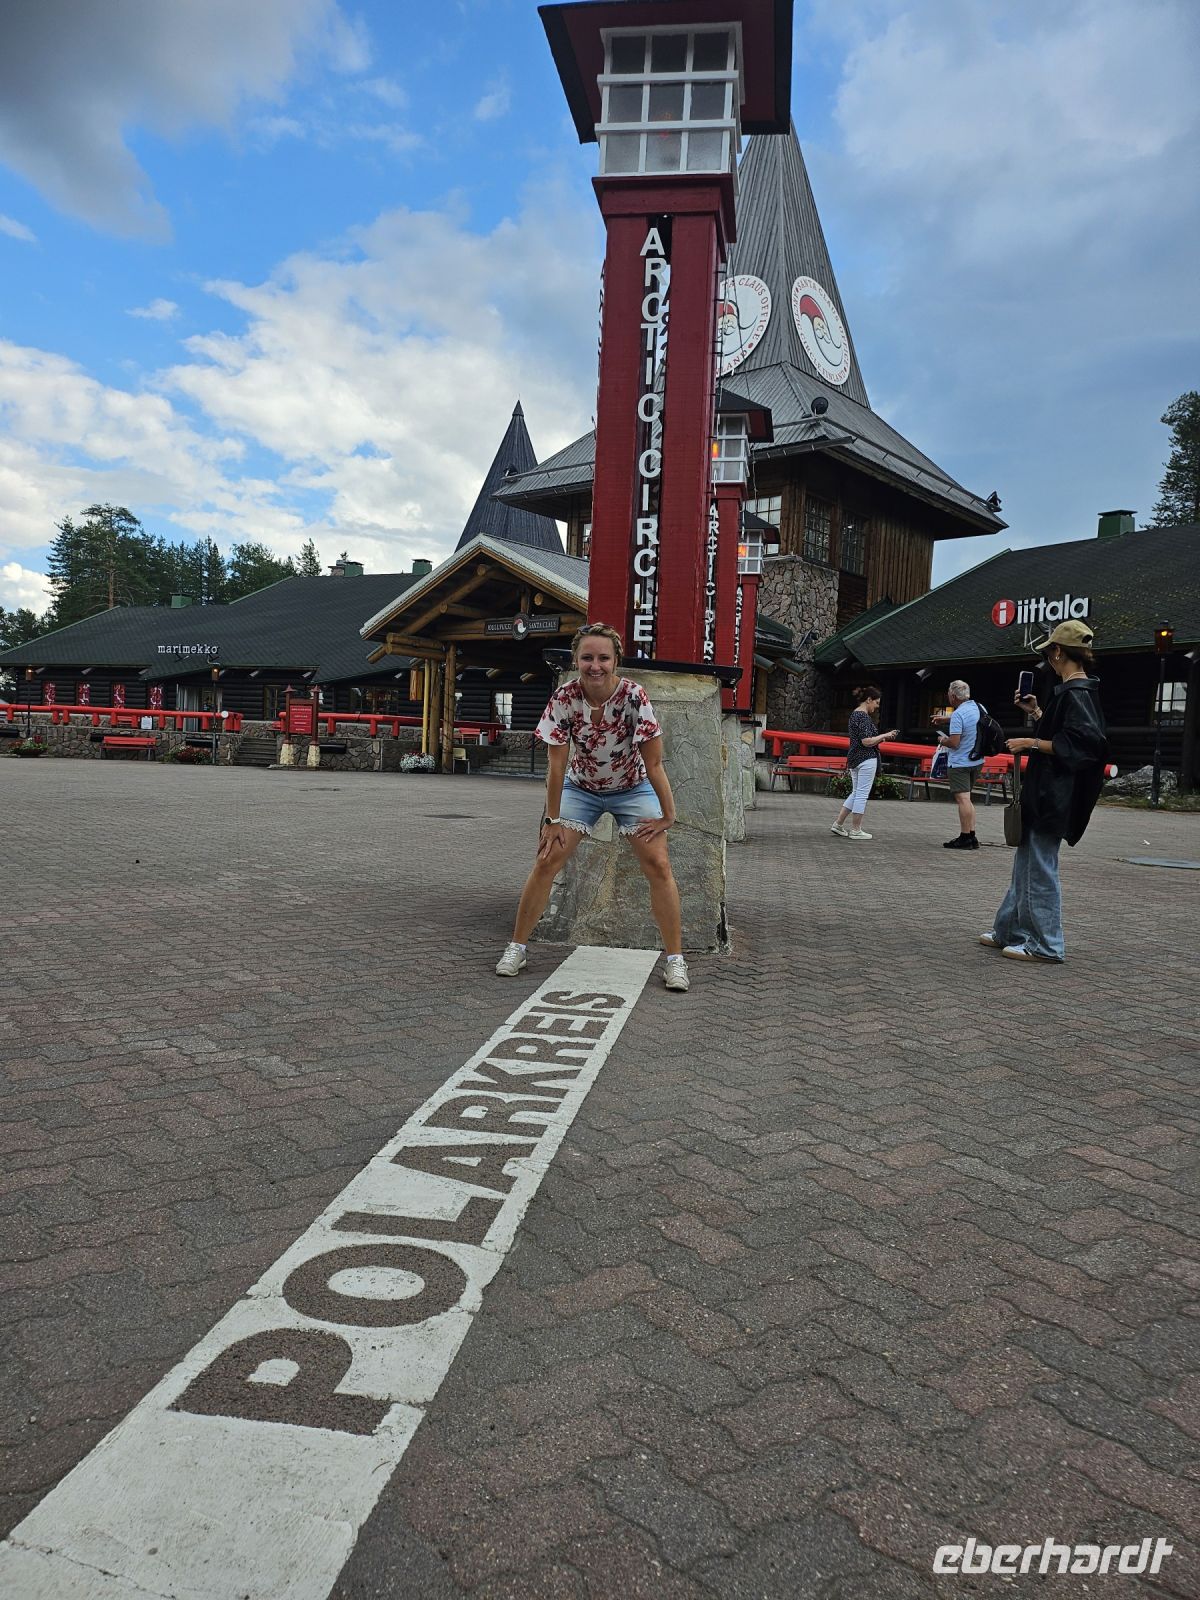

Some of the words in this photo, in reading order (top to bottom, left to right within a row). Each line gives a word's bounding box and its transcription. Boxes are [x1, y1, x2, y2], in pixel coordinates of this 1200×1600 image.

[638, 227, 667, 422] ARCTIC
[738, 277, 766, 296] CLAUS
[752, 296, 769, 340] OFFICE
[634, 449, 662, 642] CIRCLE
[1017, 594, 1089, 624] iittala
[157, 643, 219, 654] marimekko
[167, 990, 626, 1436] POLARKREIS
